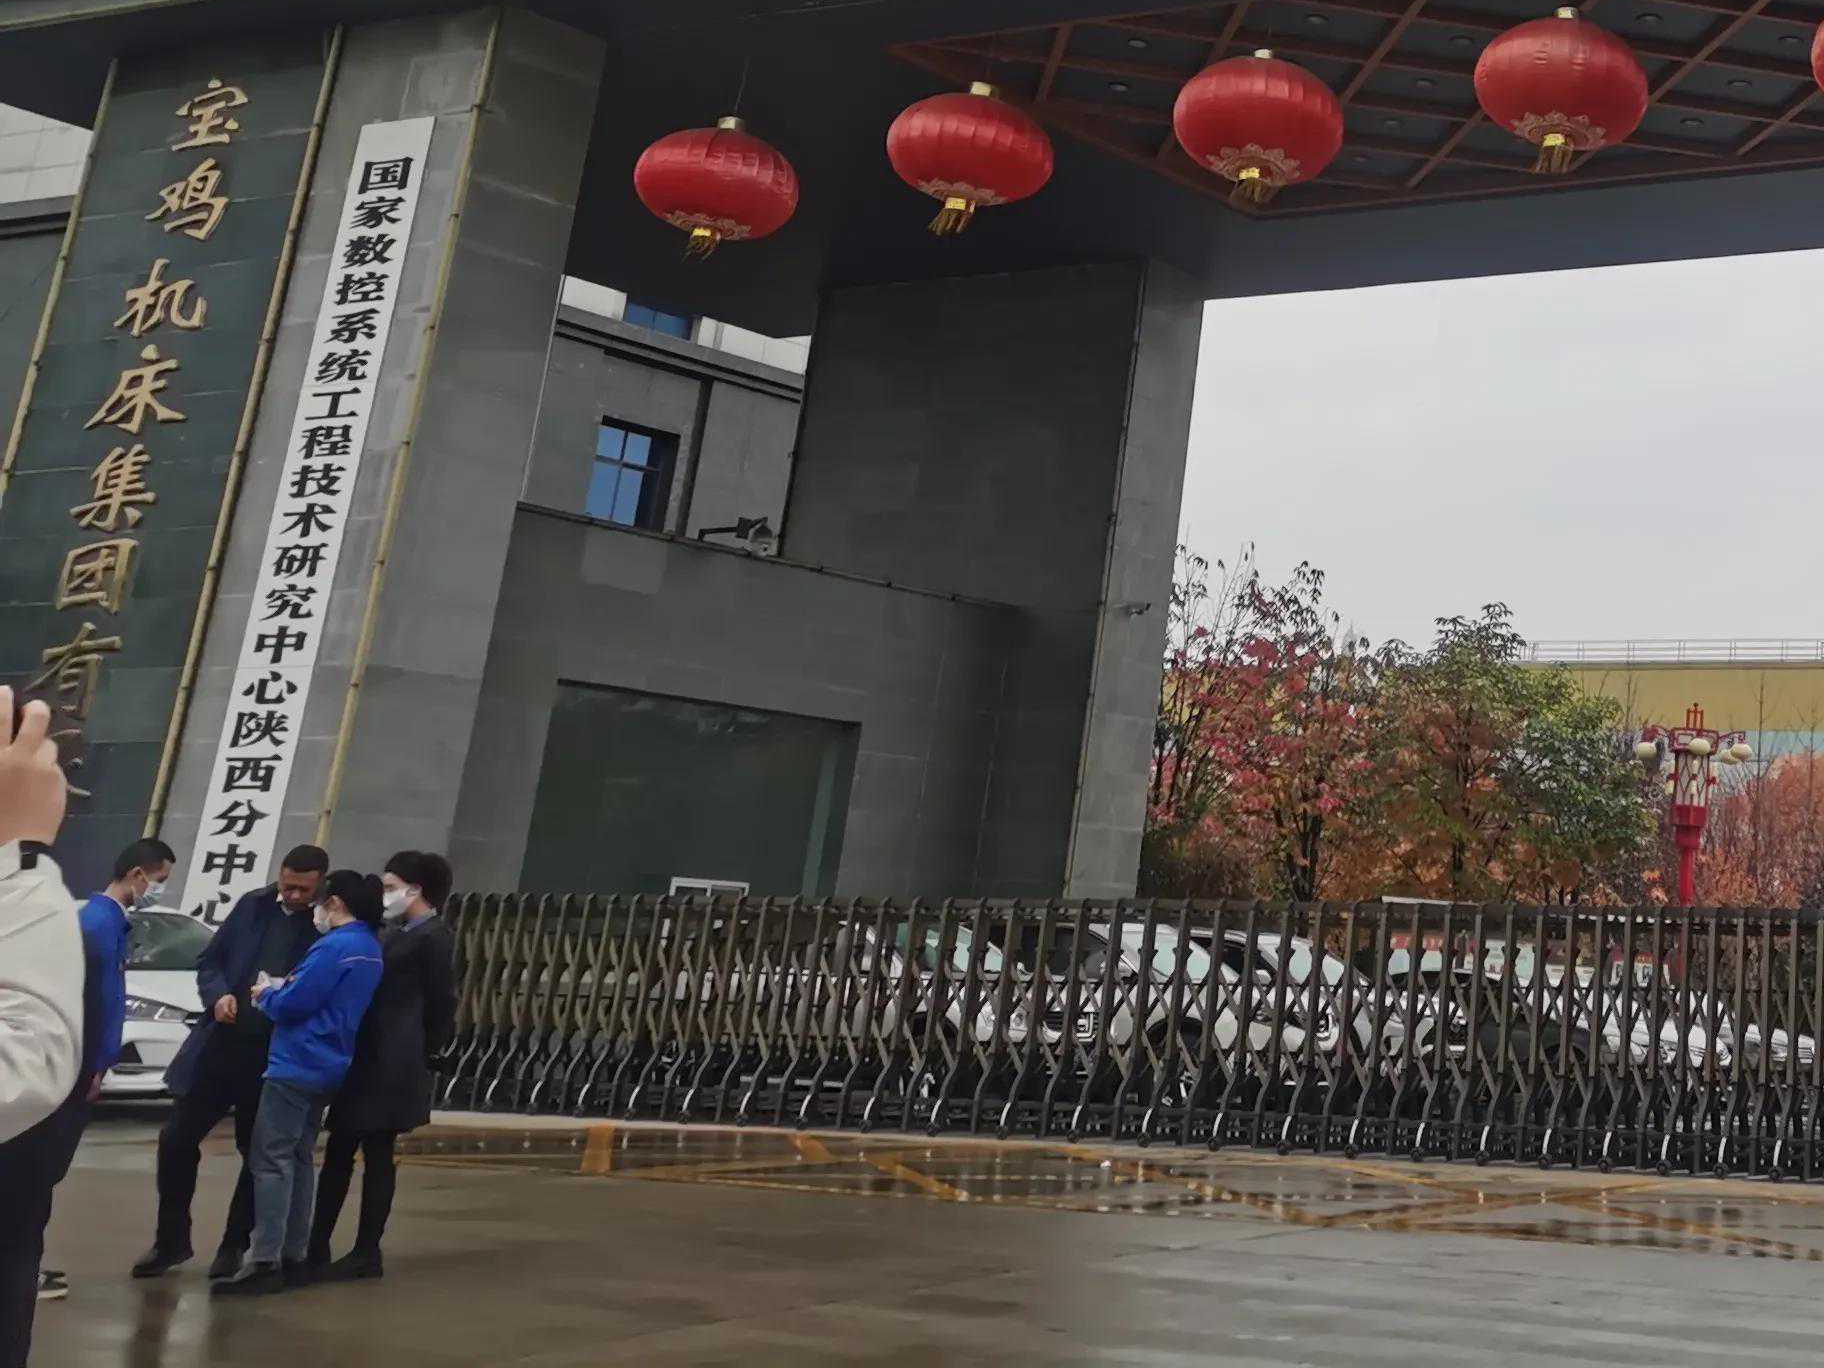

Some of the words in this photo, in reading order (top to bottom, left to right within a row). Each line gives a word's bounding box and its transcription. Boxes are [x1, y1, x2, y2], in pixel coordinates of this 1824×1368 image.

[190, 155, 414, 926] 国家数控系统工程技术研究中心陕西分中心
